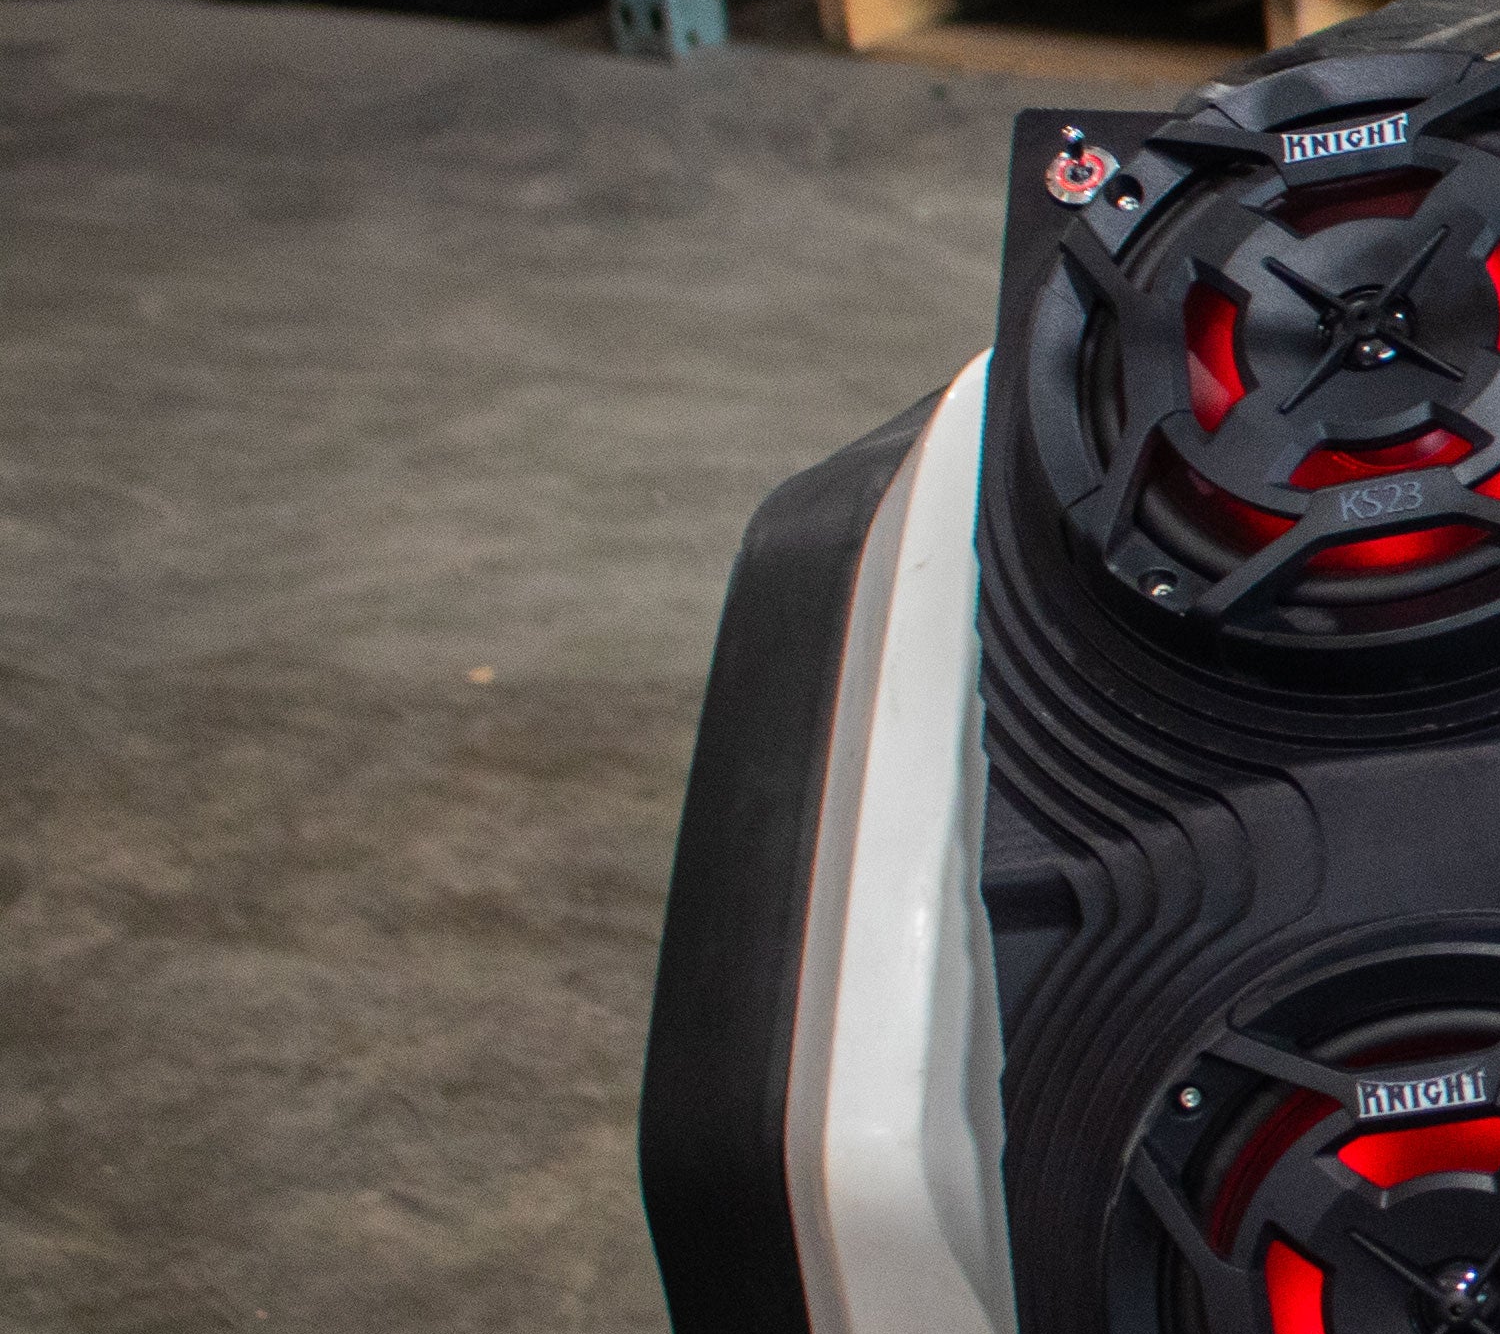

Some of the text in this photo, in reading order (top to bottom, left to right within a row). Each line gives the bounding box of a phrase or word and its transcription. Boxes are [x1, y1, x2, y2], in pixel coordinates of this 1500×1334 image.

[1282, 113, 1408, 163] KNIGHT
[1340, 481, 1424, 522] KS23
[1357, 1068, 1486, 1118] KNIGHT
